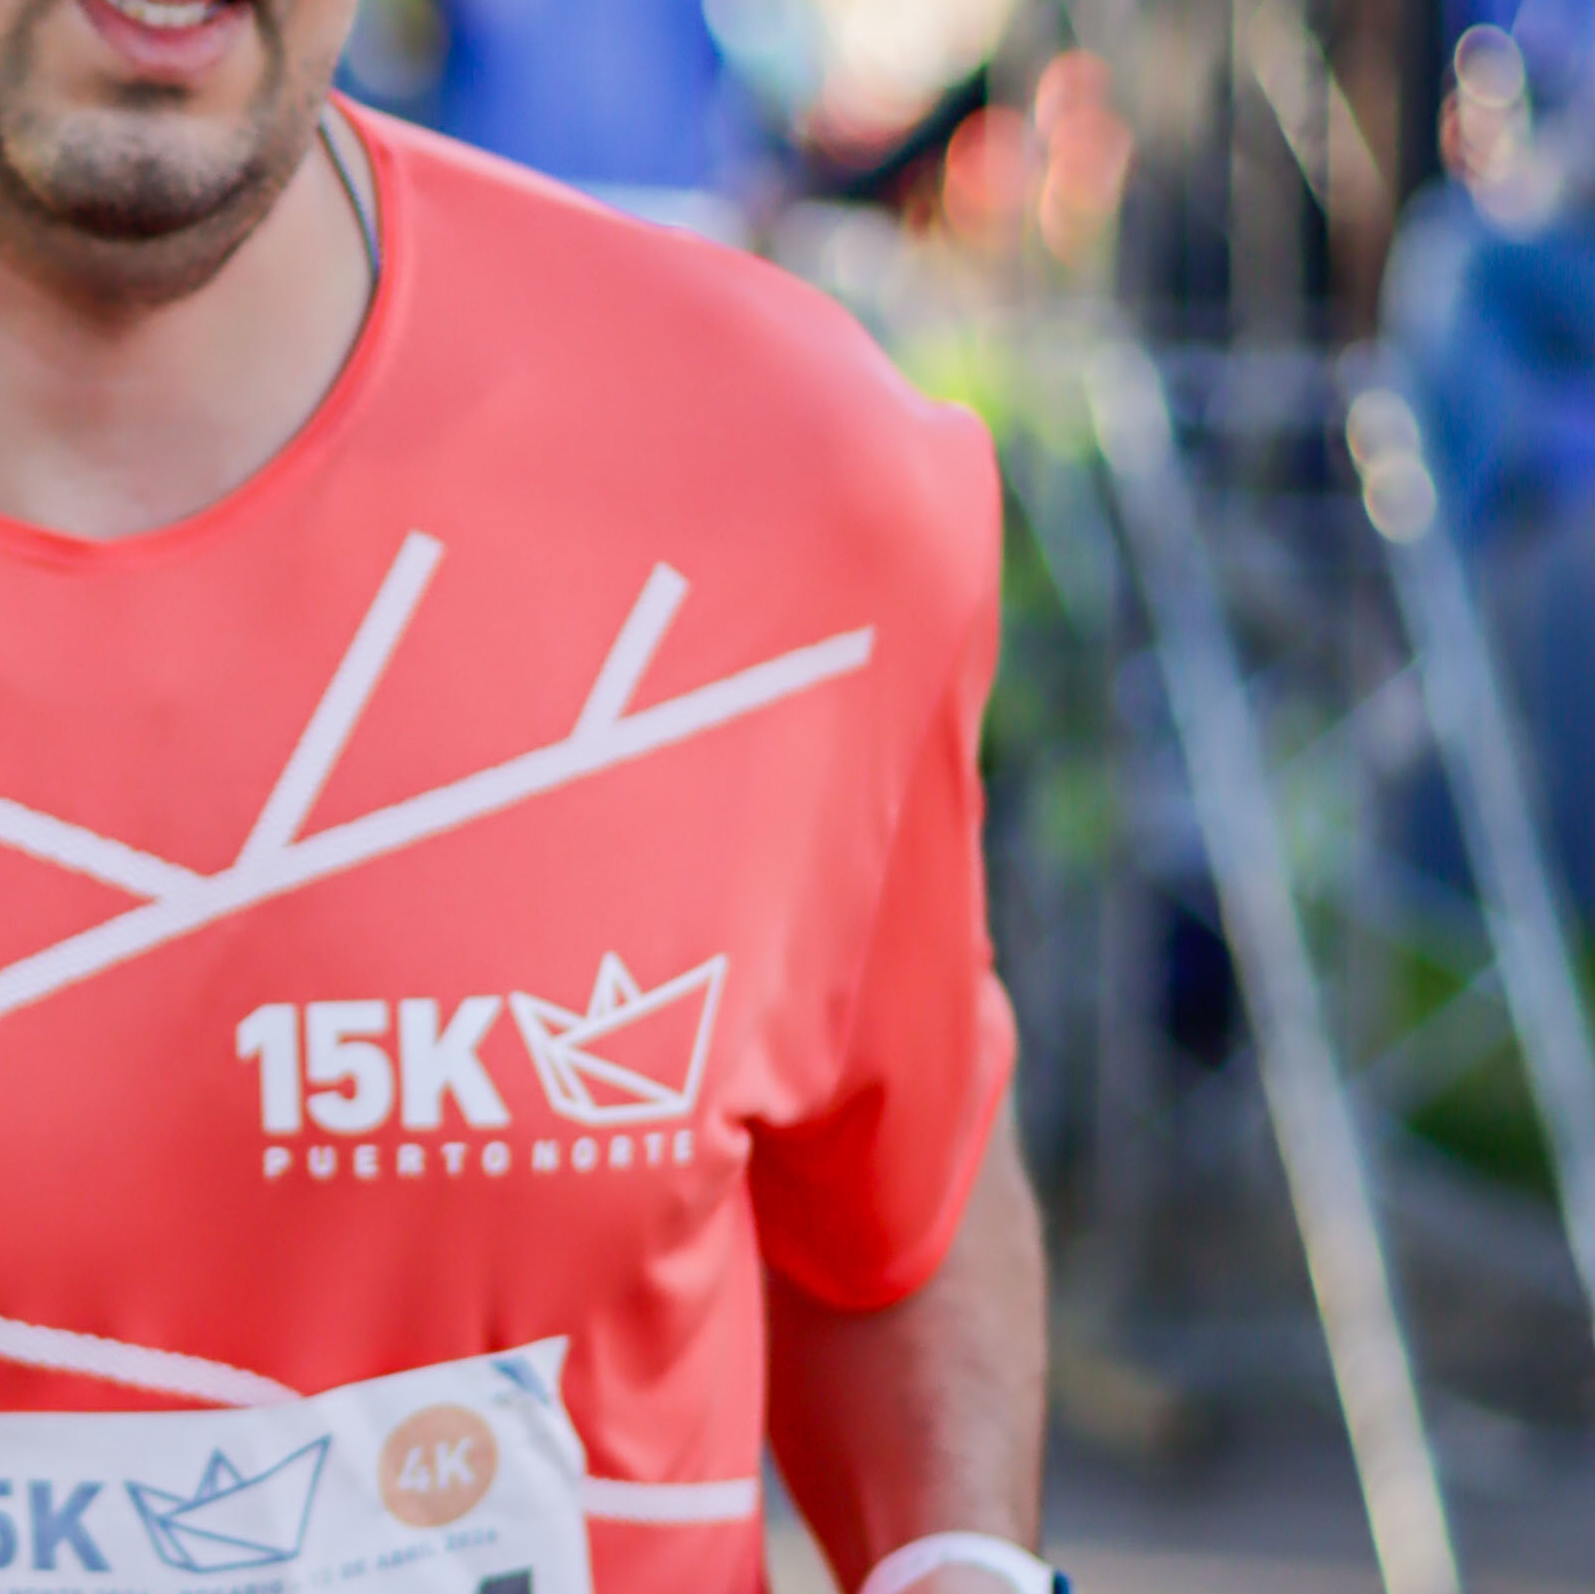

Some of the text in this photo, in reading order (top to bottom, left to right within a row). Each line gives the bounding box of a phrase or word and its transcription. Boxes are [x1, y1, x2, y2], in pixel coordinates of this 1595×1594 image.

[235, 995, 511, 1136] 15K
[263, 1128, 694, 1181] PUERTO NORTE
[399, 1436, 476, 1494] 4K
